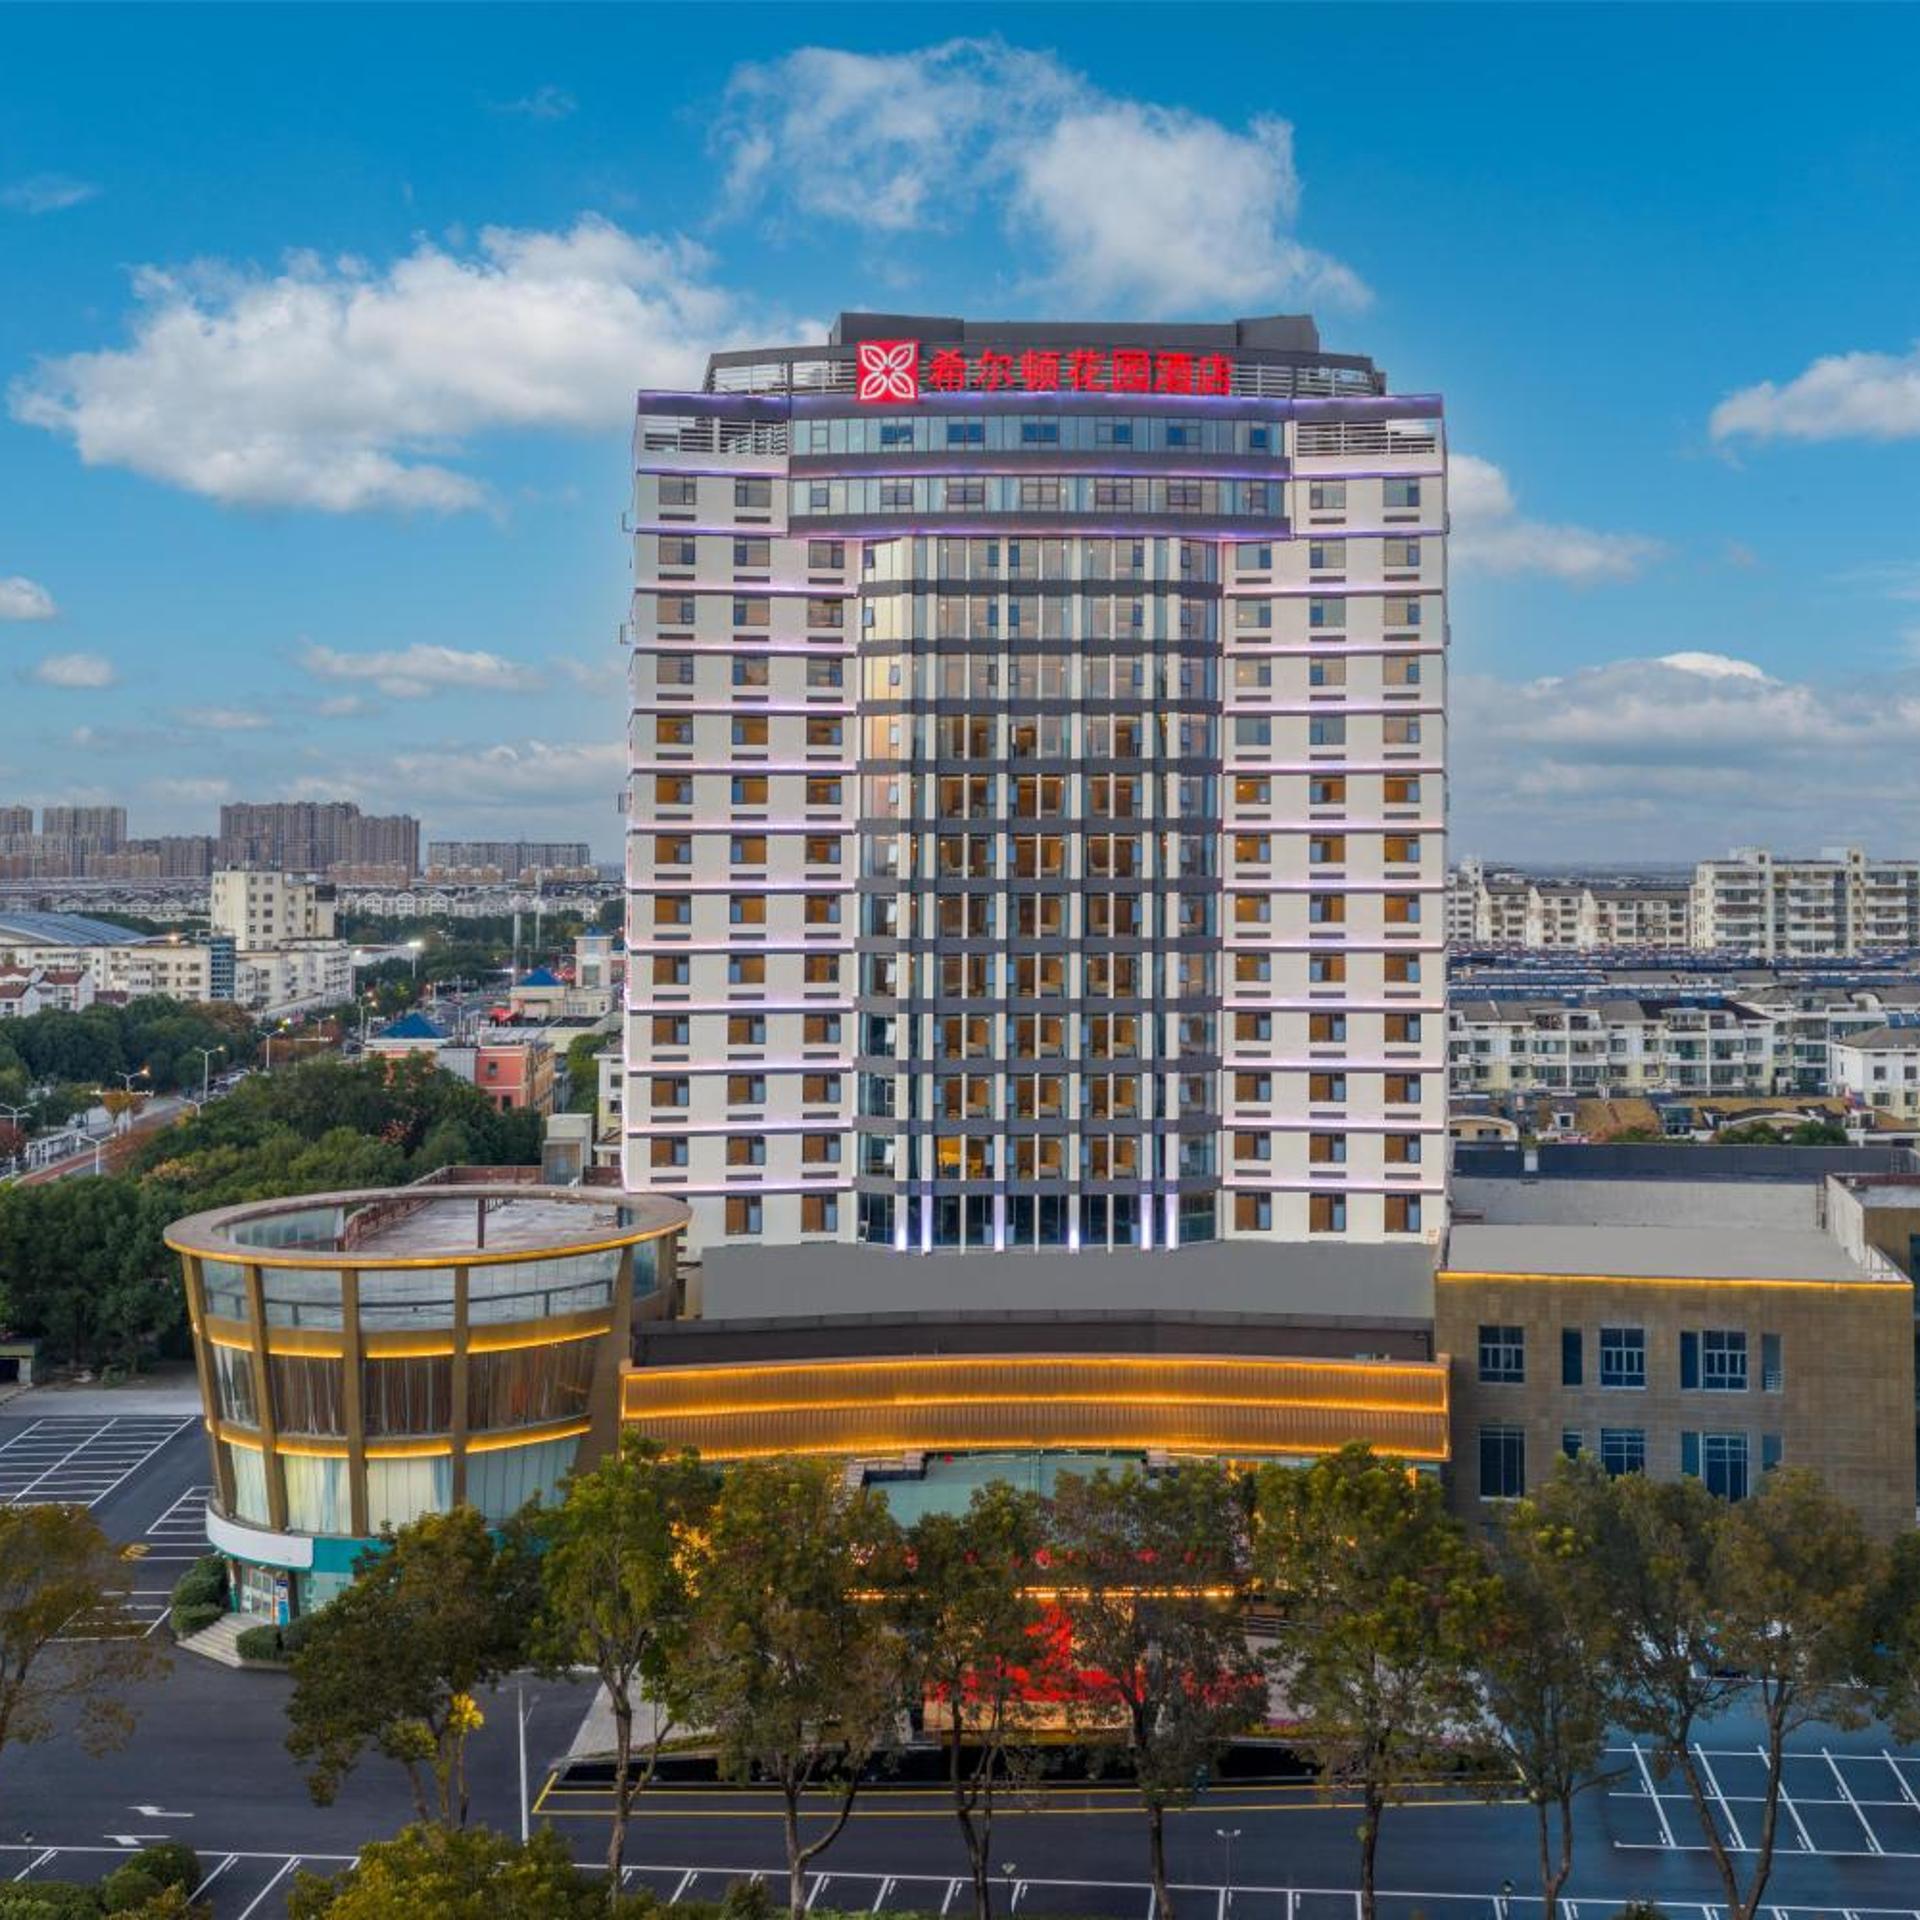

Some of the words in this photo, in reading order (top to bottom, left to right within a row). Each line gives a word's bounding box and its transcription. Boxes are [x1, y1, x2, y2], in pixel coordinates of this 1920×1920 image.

[929, 349, 1232, 394] 希尔顿花园酒店
